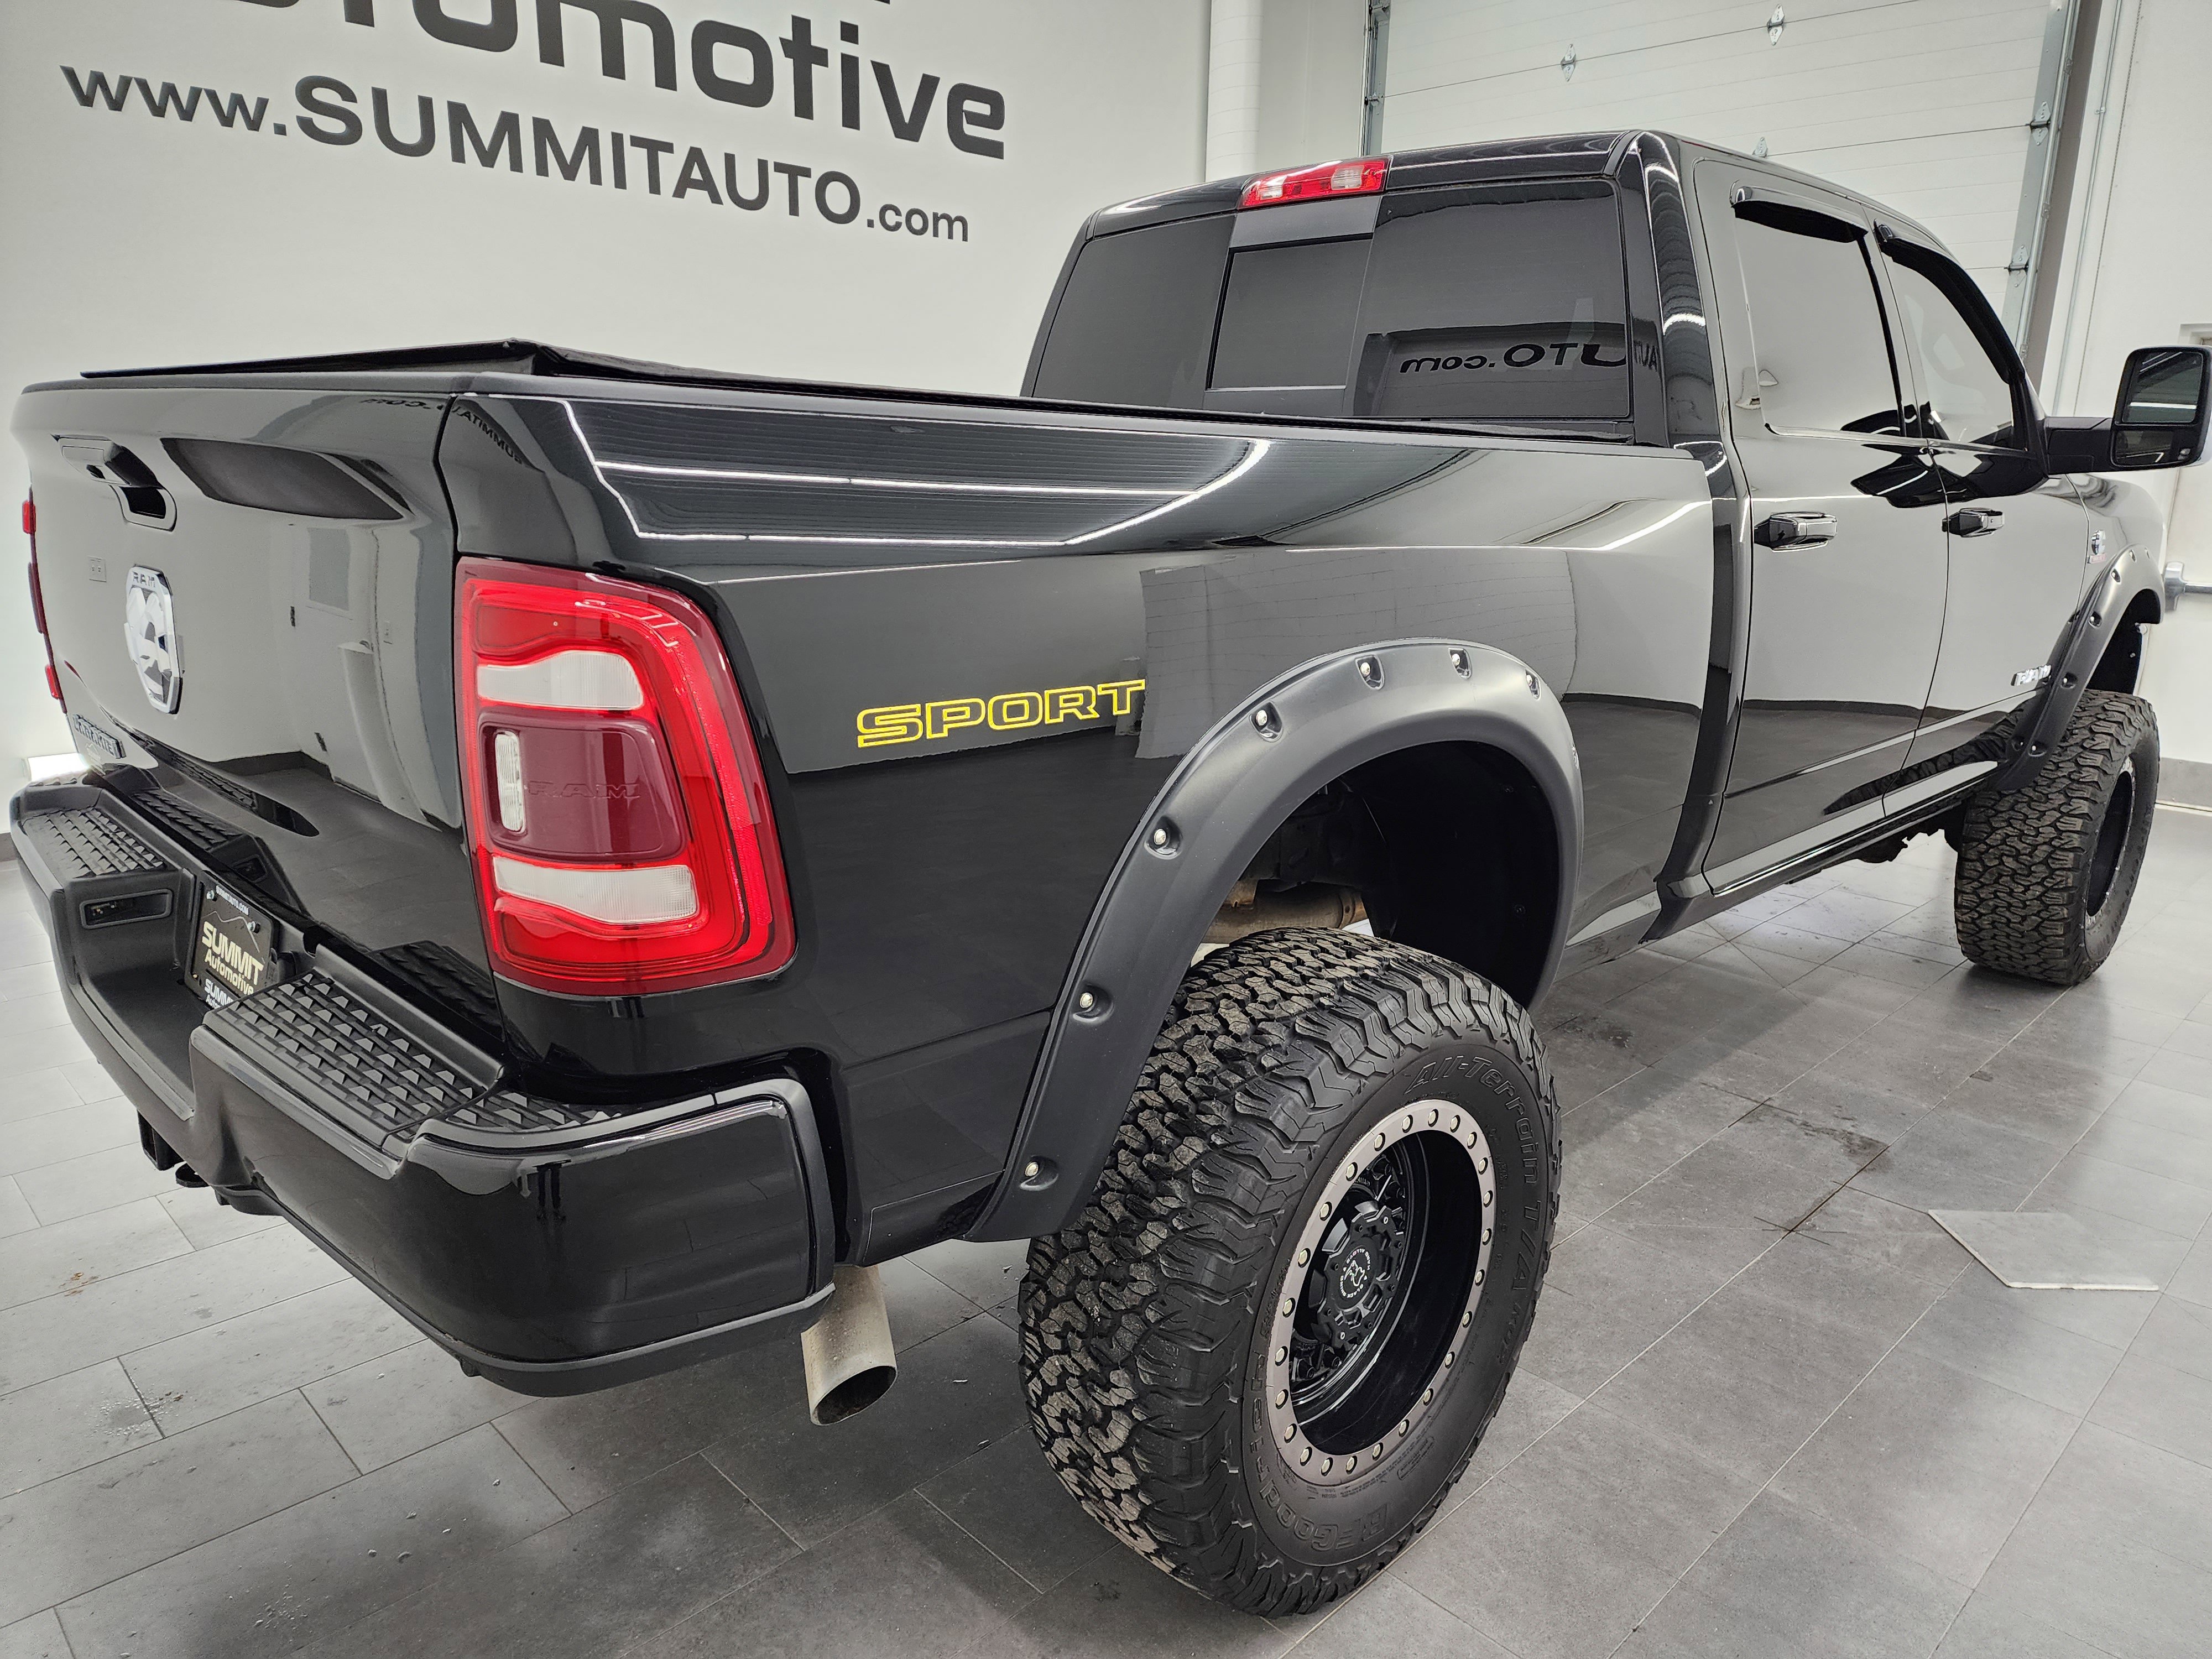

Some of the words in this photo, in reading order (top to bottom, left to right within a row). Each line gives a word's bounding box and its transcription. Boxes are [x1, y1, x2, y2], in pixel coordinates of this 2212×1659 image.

[238, 0, 1005, 160] omotive
[59, 65, 969, 242] www.SUMMITAUTO.com
[132, 571, 156, 588] RAM
[2011, 665, 2052, 686] RAM
[857, 679, 1146, 748] SPORT
[528, 780, 641, 799] RAM
[202, 921, 264, 985] SUMMIT
[204, 948, 254, 995] Automotive
[1403, 1055, 1541, 1185] All-Terrain
[1511, 1199, 1542, 1291] T/A
